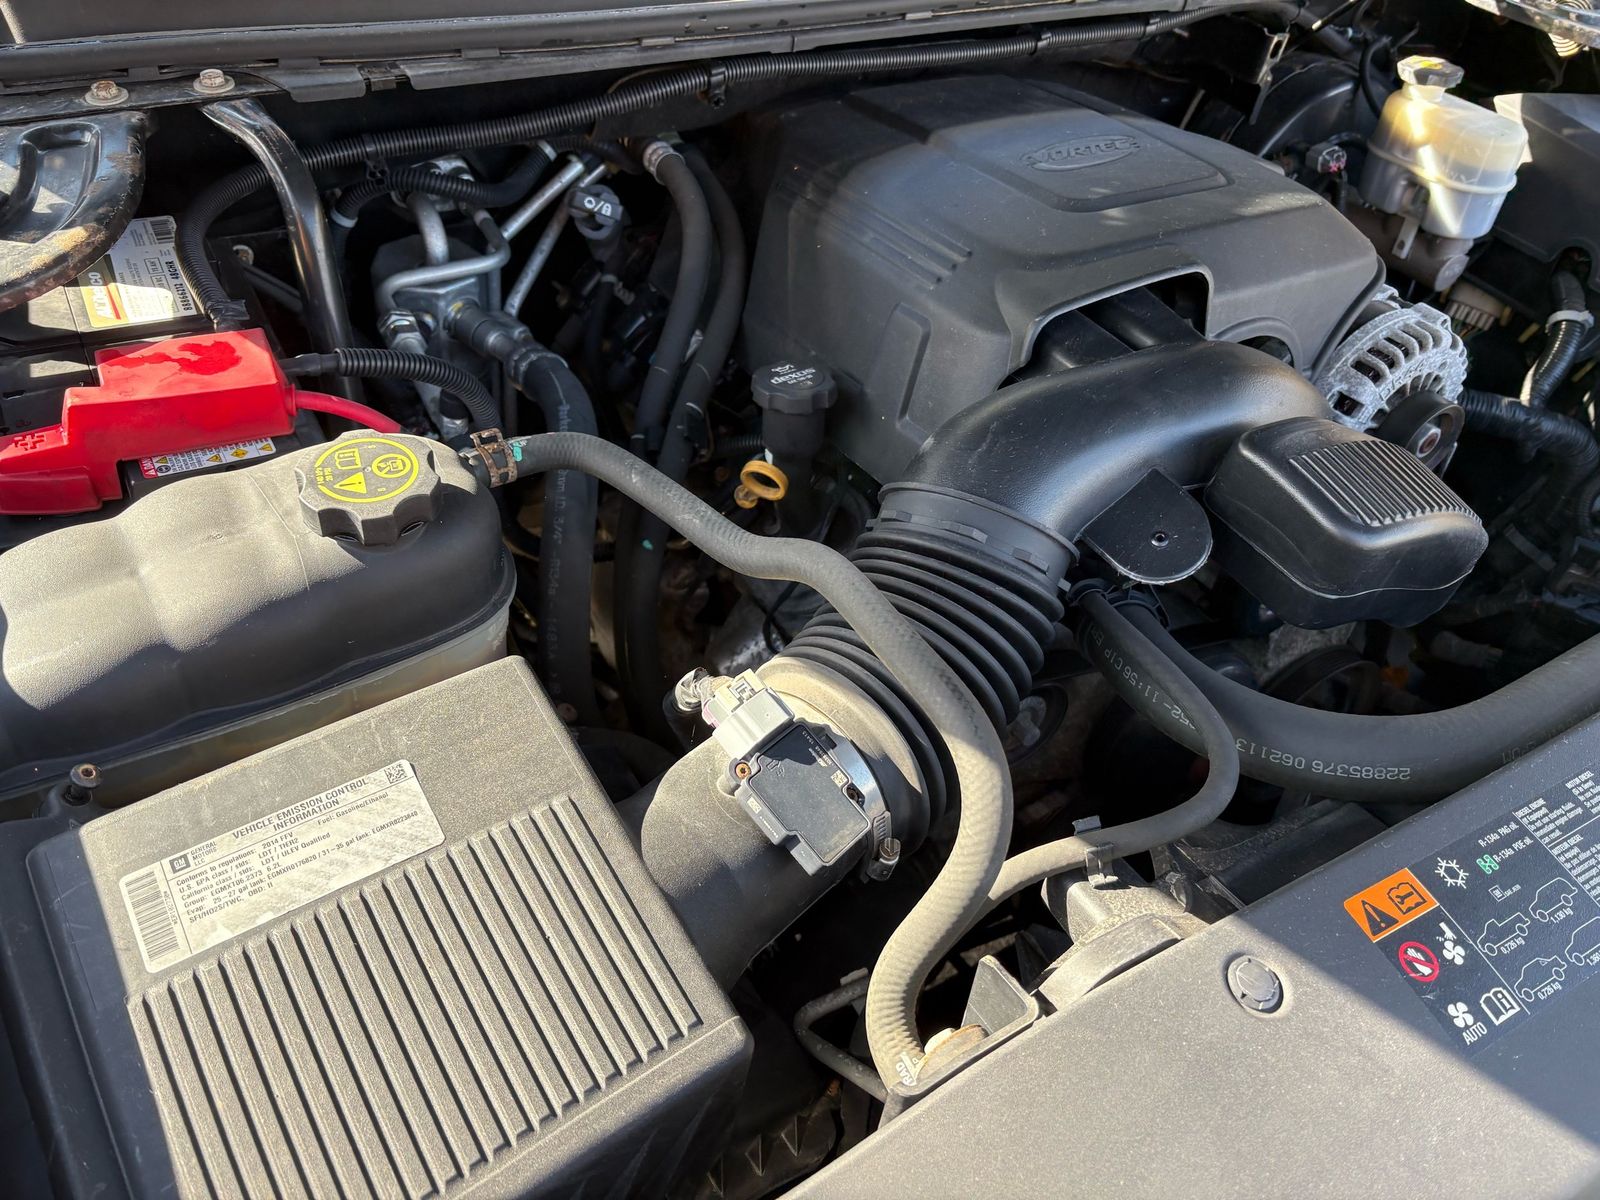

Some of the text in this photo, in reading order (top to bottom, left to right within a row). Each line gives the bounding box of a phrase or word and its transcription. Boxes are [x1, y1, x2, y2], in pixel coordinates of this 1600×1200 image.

[770, 367, 816, 384] dexos
[1235, 738, 1305, 770] 062113
[1312, 760, 1410, 780] 22885376
[232, 776, 368, 840] VEHICLE EMISSION CONTROL
[272, 797, 339, 833] INFORMATION
[317, 790, 389, 826] Fuel: Gasoline/Ethanol
[1498, 826, 1511, 837] PAG
[175, 831, 293, 887] Conforms to regulations: 2014 FFV
[190, 840, 216, 856] GENERAL
[192, 846, 217, 861] MOTORS
[1493, 848, 1514, 863] R-134a
[178, 882, 195, 894] U.S.
[195, 875, 210, 886] EPA
[211, 867, 229, 879] class
[258, 848, 272, 859] LDT
[279, 837, 299, 850] TIER2
[180, 882, 214, 901] California
[214, 874, 232, 886] class
[260, 855, 275, 866] LDT
[281, 845, 300, 857] ULEV
[300, 831, 331, 849] Qualified
[193, 857, 205, 866] LLC
[183, 893, 208, 909] Group:
[266, 860, 282, 872] 6.2L
[186, 902, 206, 917] Evap:
[237, 884, 249, 894] gal
[249, 876, 266, 888] tank:
[267, 853, 317, 880] EGMXR0176820
[344, 837, 355, 847] gal
[188, 894, 244, 924] SFI/HO2S/TWC,
[247, 885, 265, 897] OBD:
[1550, 907, 1573, 924] 1,130 kg
[1500, 936, 1525, 955] 0,726 kg
[1538, 981, 1562, 1000] 0,726 kg
[1462, 1022, 1487, 1045] AUTO
